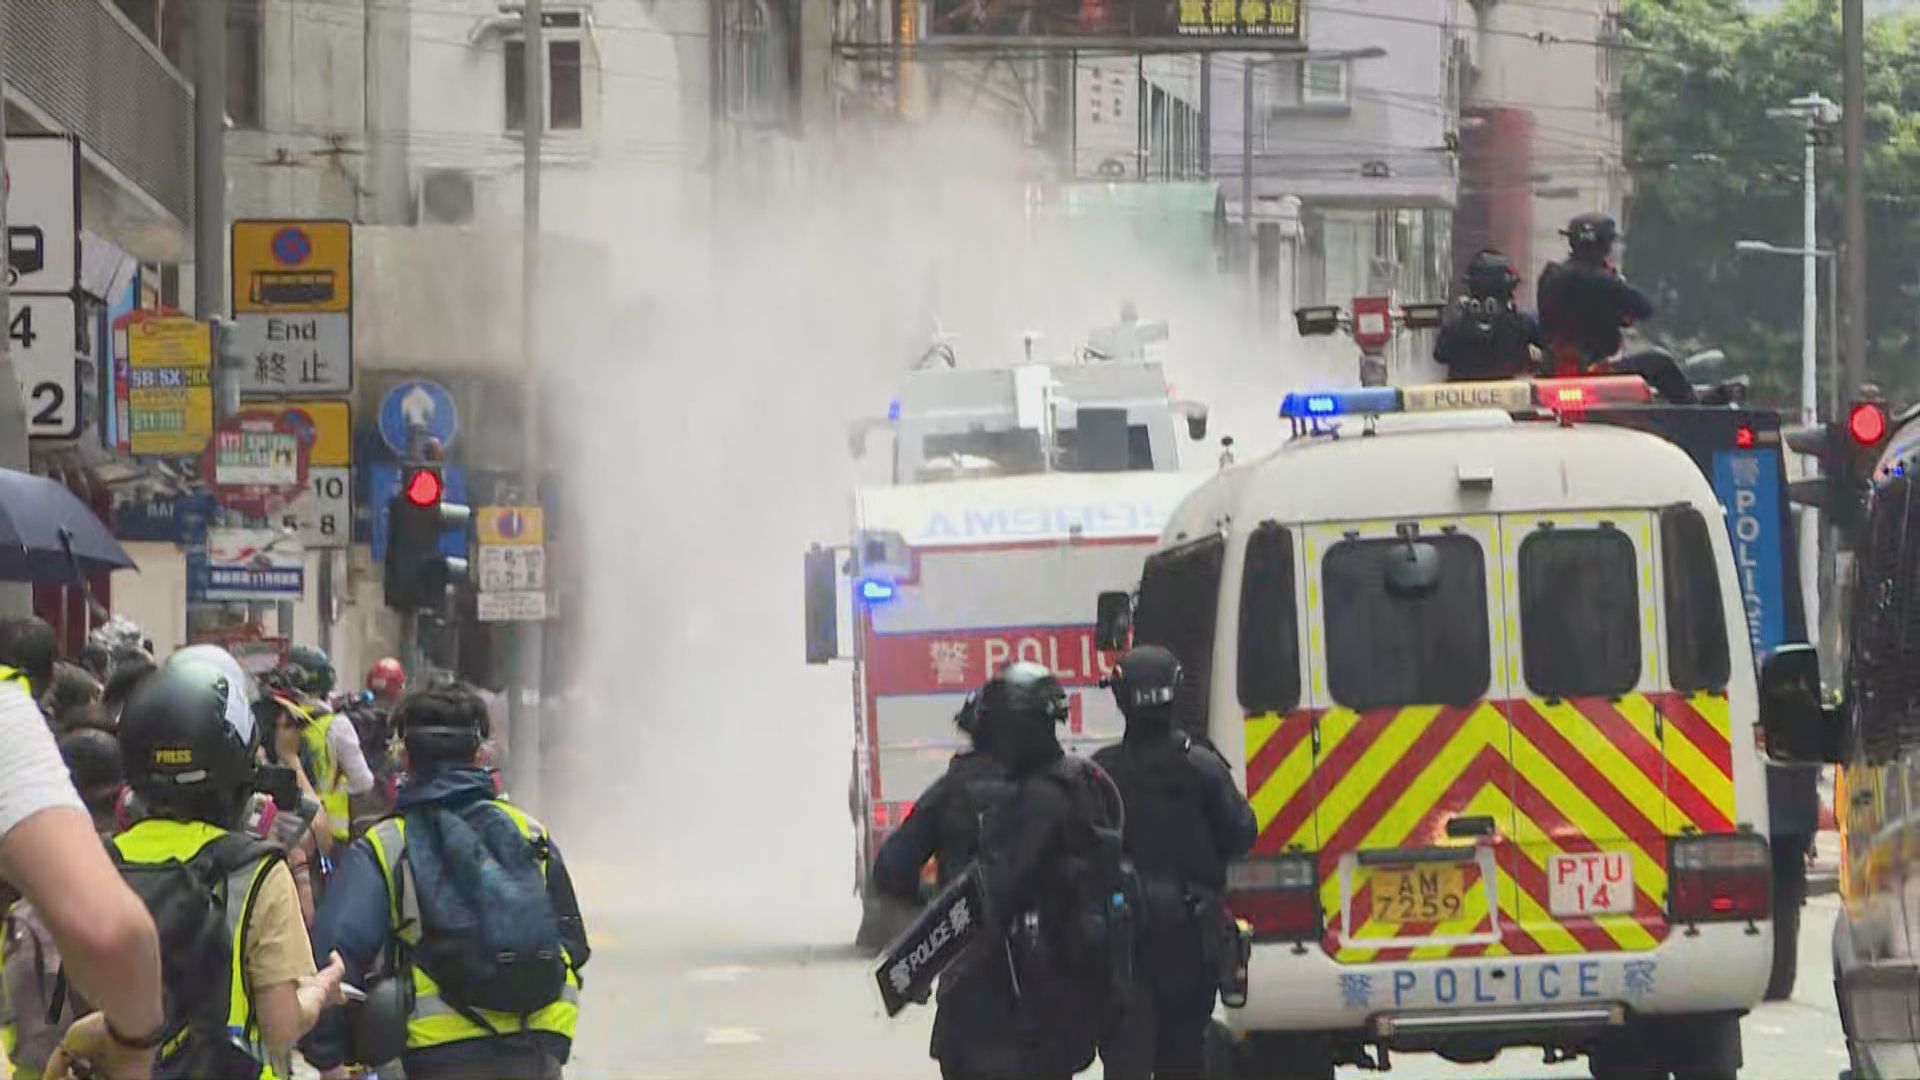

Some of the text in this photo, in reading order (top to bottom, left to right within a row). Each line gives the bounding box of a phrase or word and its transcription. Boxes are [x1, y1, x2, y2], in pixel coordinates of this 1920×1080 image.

[9, 306, 36, 348] 4
[268, 319, 317, 341] End
[255, 351, 331, 385] 終止
[32, 382, 64, 425] 2
[1434, 388, 1500, 406] POLICE
[315, 478, 343, 499] 10
[1734, 490, 1763, 644] POLICE
[156, 750, 193, 764] PRESS
[1399, 871, 1438, 896] AM
[1557, 854, 1624, 884] PTU
[1375, 894, 1461, 920] 7259
[1576, 881, 1612, 911] 14
[909, 919, 952, 972] POLICE
[1338, 959, 1659, 1008] 警 POLICE 察
